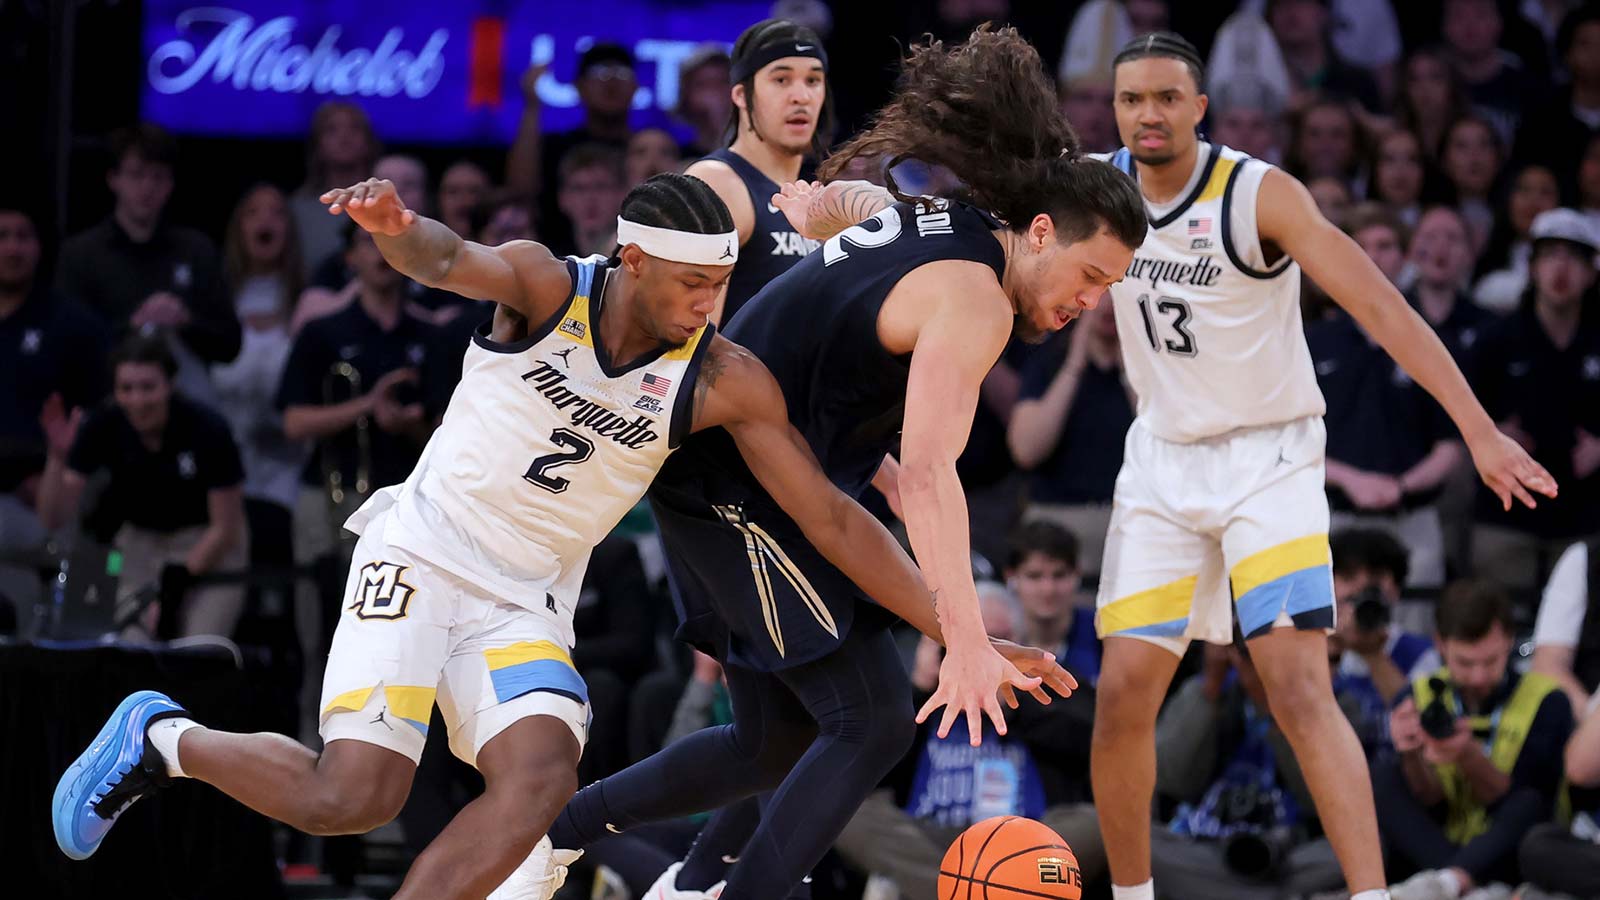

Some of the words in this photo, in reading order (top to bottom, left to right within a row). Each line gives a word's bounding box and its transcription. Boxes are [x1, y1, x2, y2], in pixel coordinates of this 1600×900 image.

[1137, 293, 1199, 359] 13
[520, 360, 659, 450] Marquette
[634, 400, 665, 413] EAST
[639, 394, 661, 406] BIG
[521, 427, 596, 495] 2
[346, 560, 418, 622] MU
